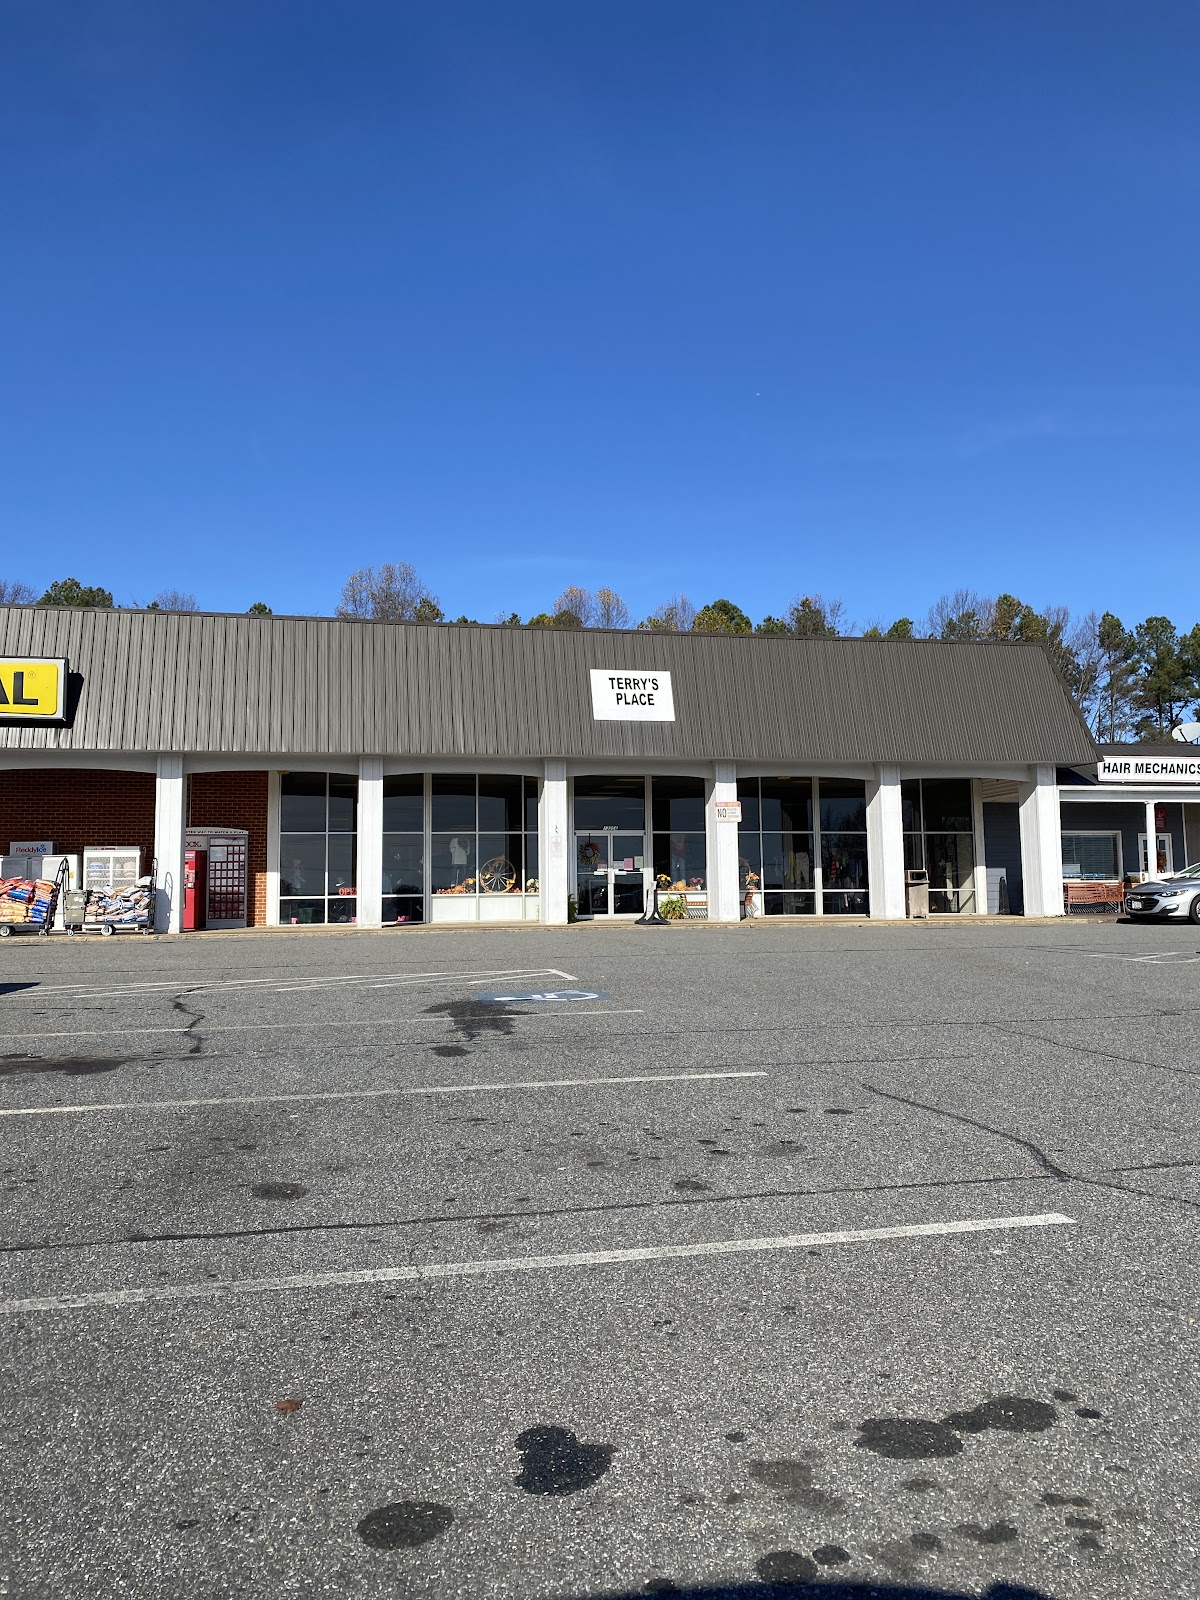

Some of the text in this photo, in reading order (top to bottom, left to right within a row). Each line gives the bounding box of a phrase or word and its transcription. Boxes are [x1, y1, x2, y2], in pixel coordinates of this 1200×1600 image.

[608, 677, 659, 691] TERRY'S
[616, 693, 655, 706] PLACE
[1103, 762, 1131, 774] HAIR
[717, 808, 727, 818] NO
